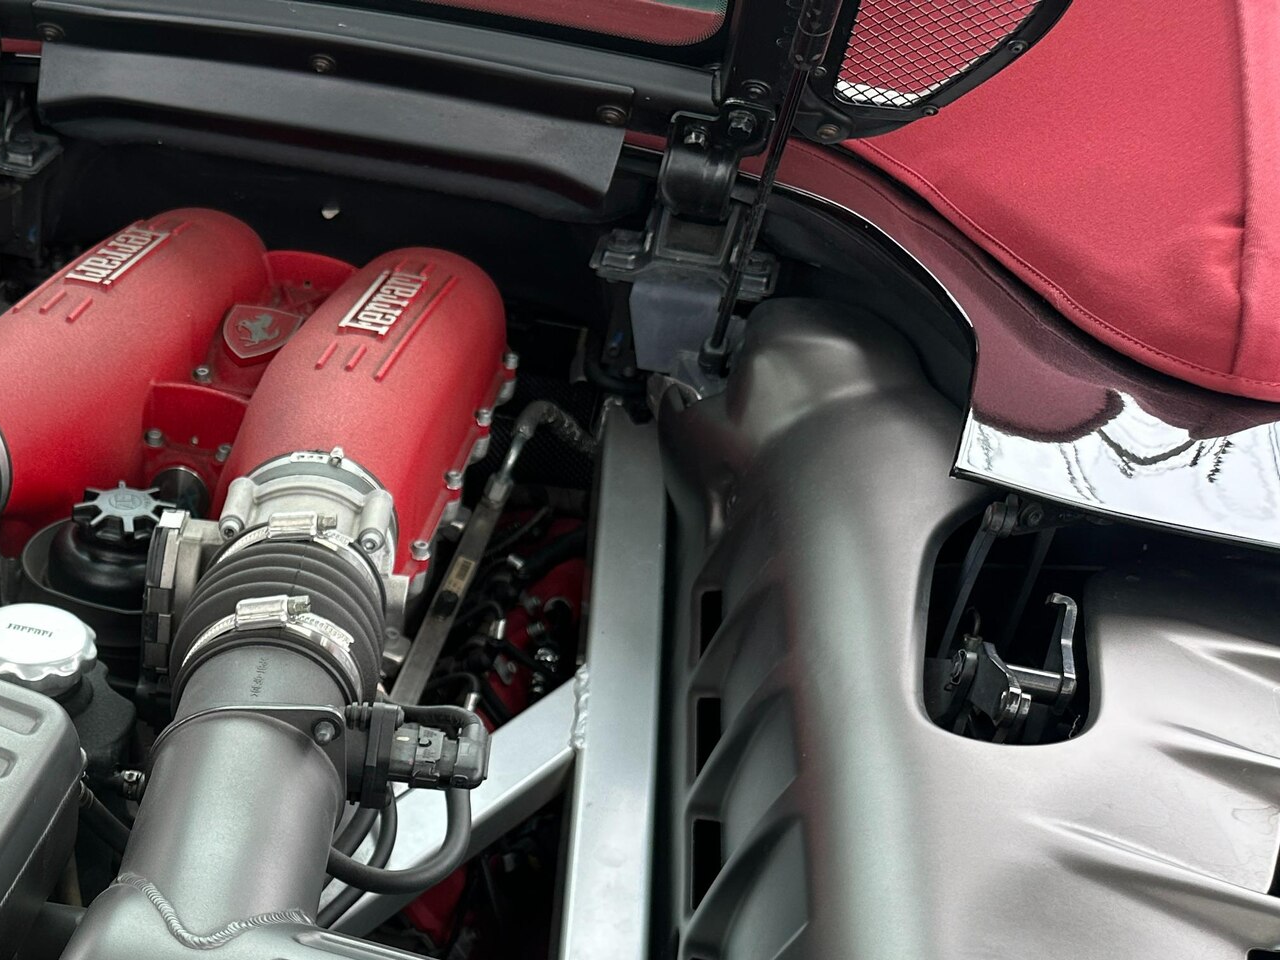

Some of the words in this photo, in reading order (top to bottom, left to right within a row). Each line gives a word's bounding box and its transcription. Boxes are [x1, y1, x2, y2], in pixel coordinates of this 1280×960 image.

[64, 226, 171, 285] Ferrari
[338, 270, 427, 336] Ferrari
[6, 622, 54, 638] Ferrari
